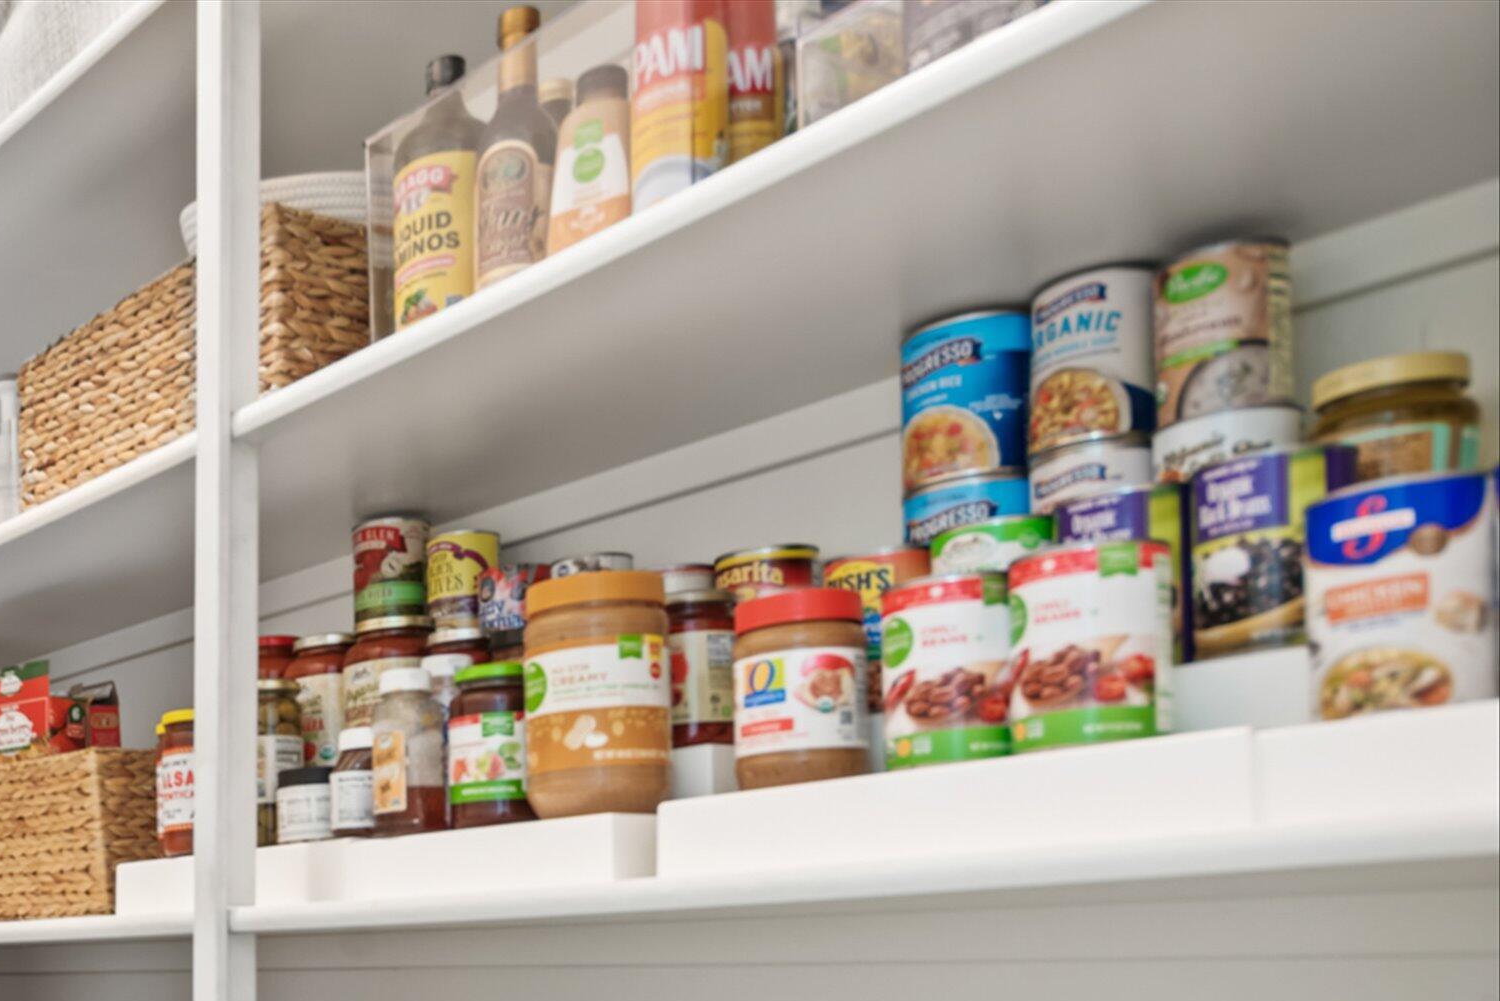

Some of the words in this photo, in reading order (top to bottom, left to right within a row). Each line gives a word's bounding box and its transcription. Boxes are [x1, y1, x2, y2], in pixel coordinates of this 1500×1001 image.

[401, 210, 453, 242] IQUID
[399, 231, 461, 263] MINOS
[716, 560, 784, 591] sarita
